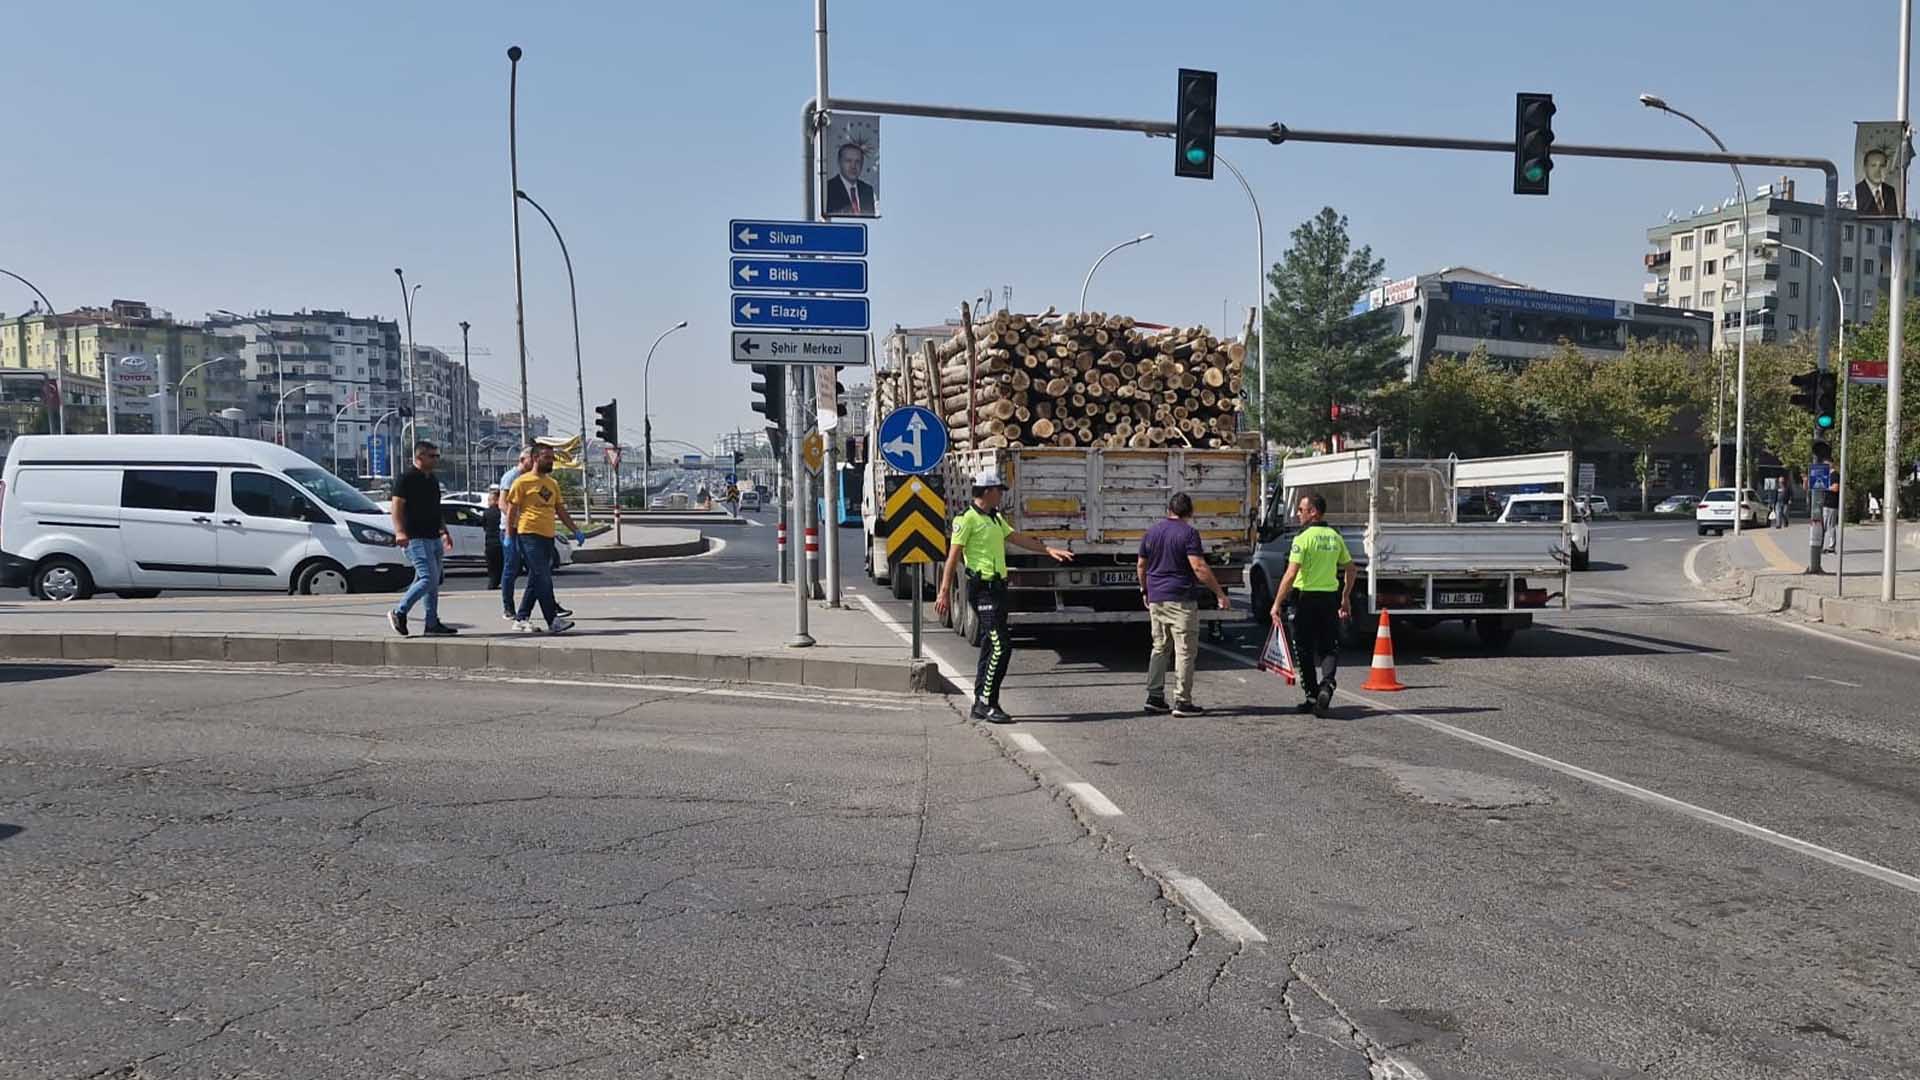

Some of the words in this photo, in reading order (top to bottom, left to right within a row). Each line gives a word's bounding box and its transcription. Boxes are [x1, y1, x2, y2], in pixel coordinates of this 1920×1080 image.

[769, 231, 803, 245] Silvan
[769, 268, 799, 281] Bitlis
[771, 305, 807, 320] Elazığ
[771, 341, 798, 356] Şehir
[803, 343, 842, 354] Merkezi
